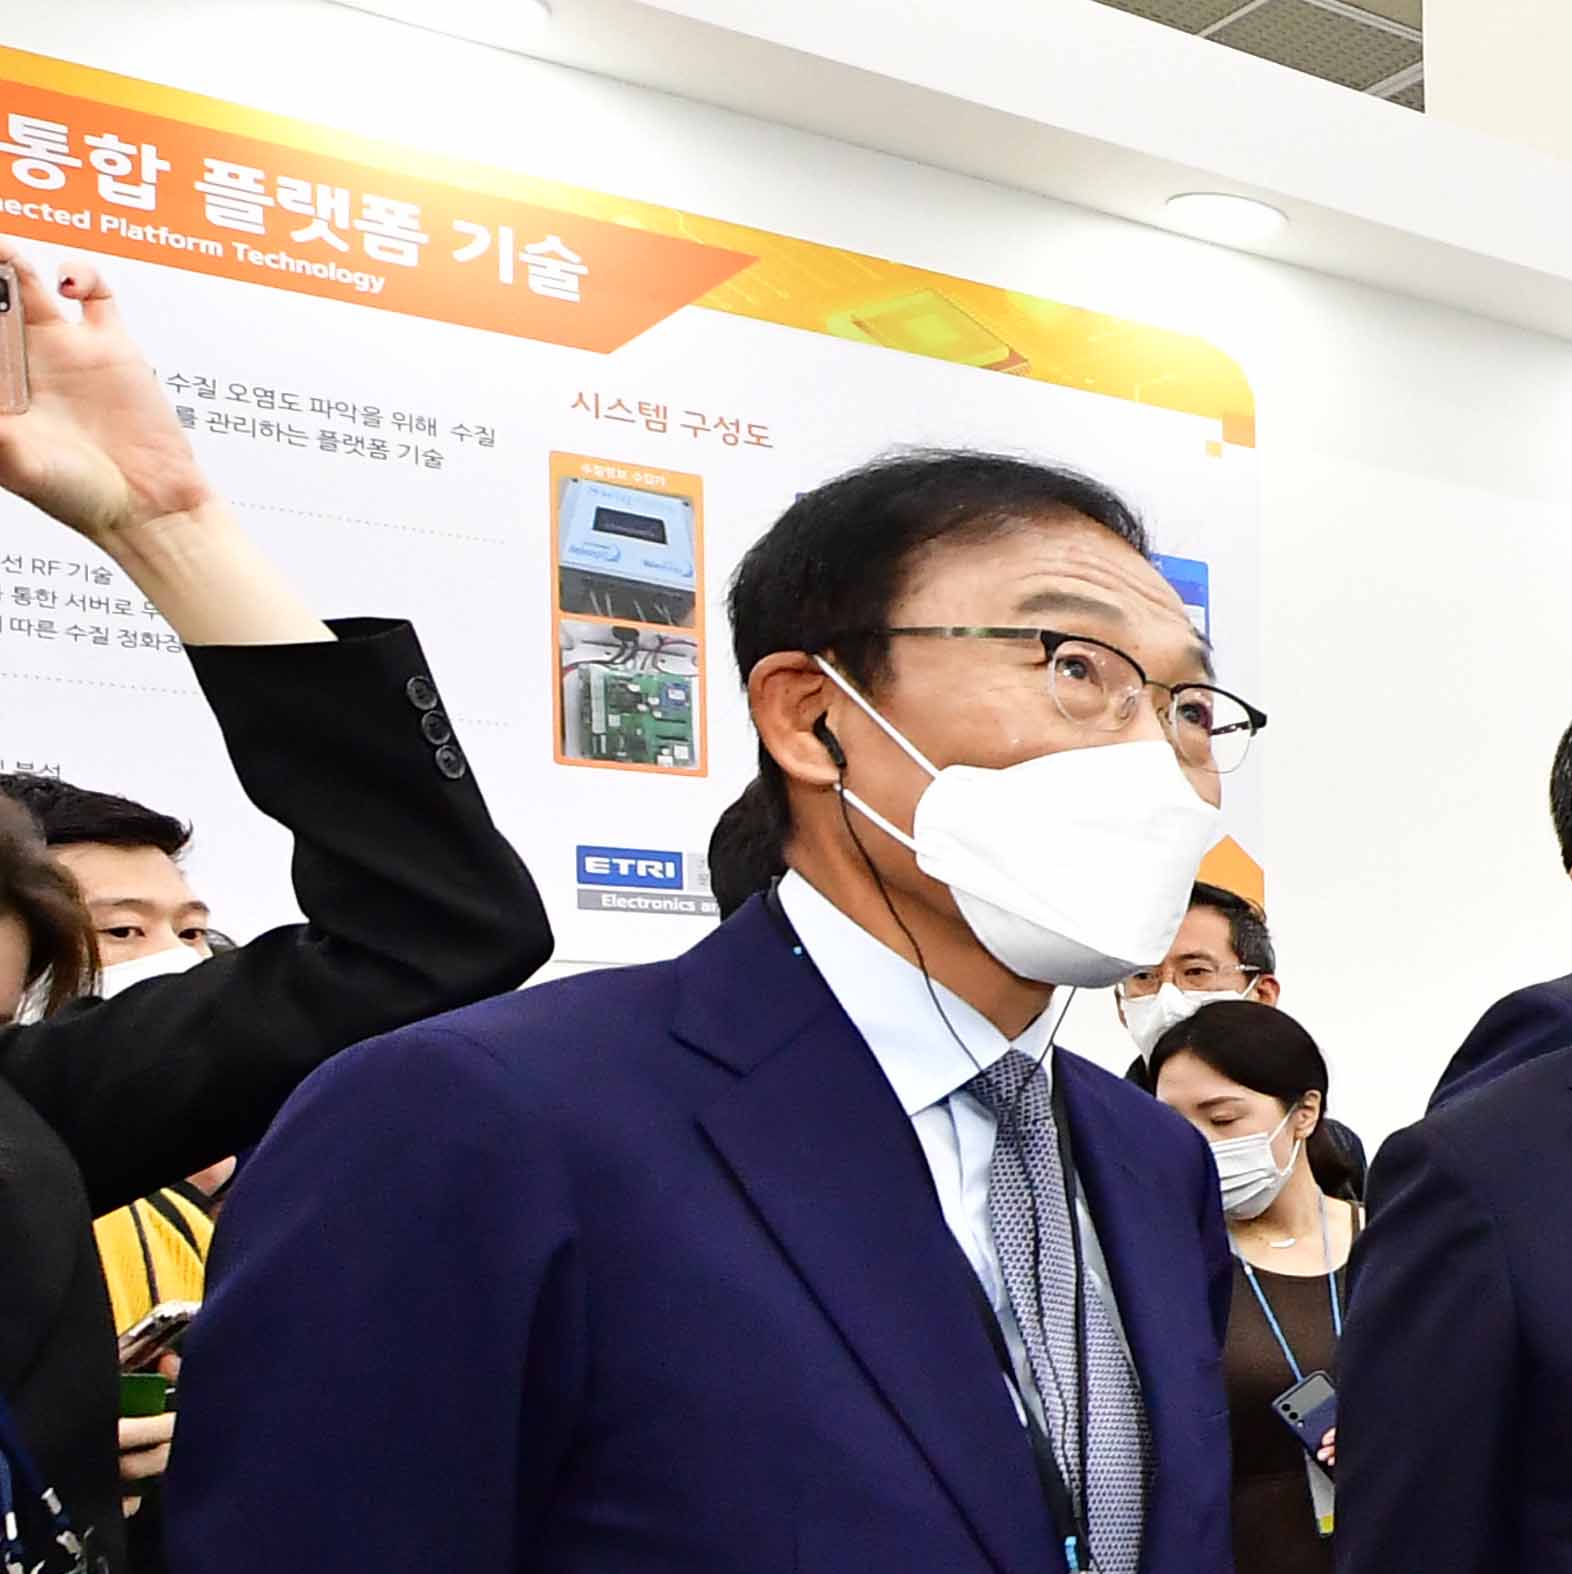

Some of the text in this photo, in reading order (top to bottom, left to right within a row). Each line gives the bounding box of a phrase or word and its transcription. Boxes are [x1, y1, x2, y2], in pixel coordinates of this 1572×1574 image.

[0, 112, 590, 304] 통합 플랫폼 기술
[0, 197, 386, 294] ected Platform Technology
[166, 372, 497, 449] 수질 오염도 파악을 위해 수질
[570, 391, 774, 449] 시스템 구성도
[204, 411, 310, 449] 관리하는
[397, 443, 445, 470] 기술
[65, 594, 135, 616] 서버로
[66, 623, 110, 646] 수질
[584, 856, 676, 880] ETRI
[601, 892, 696, 914] Electronics
